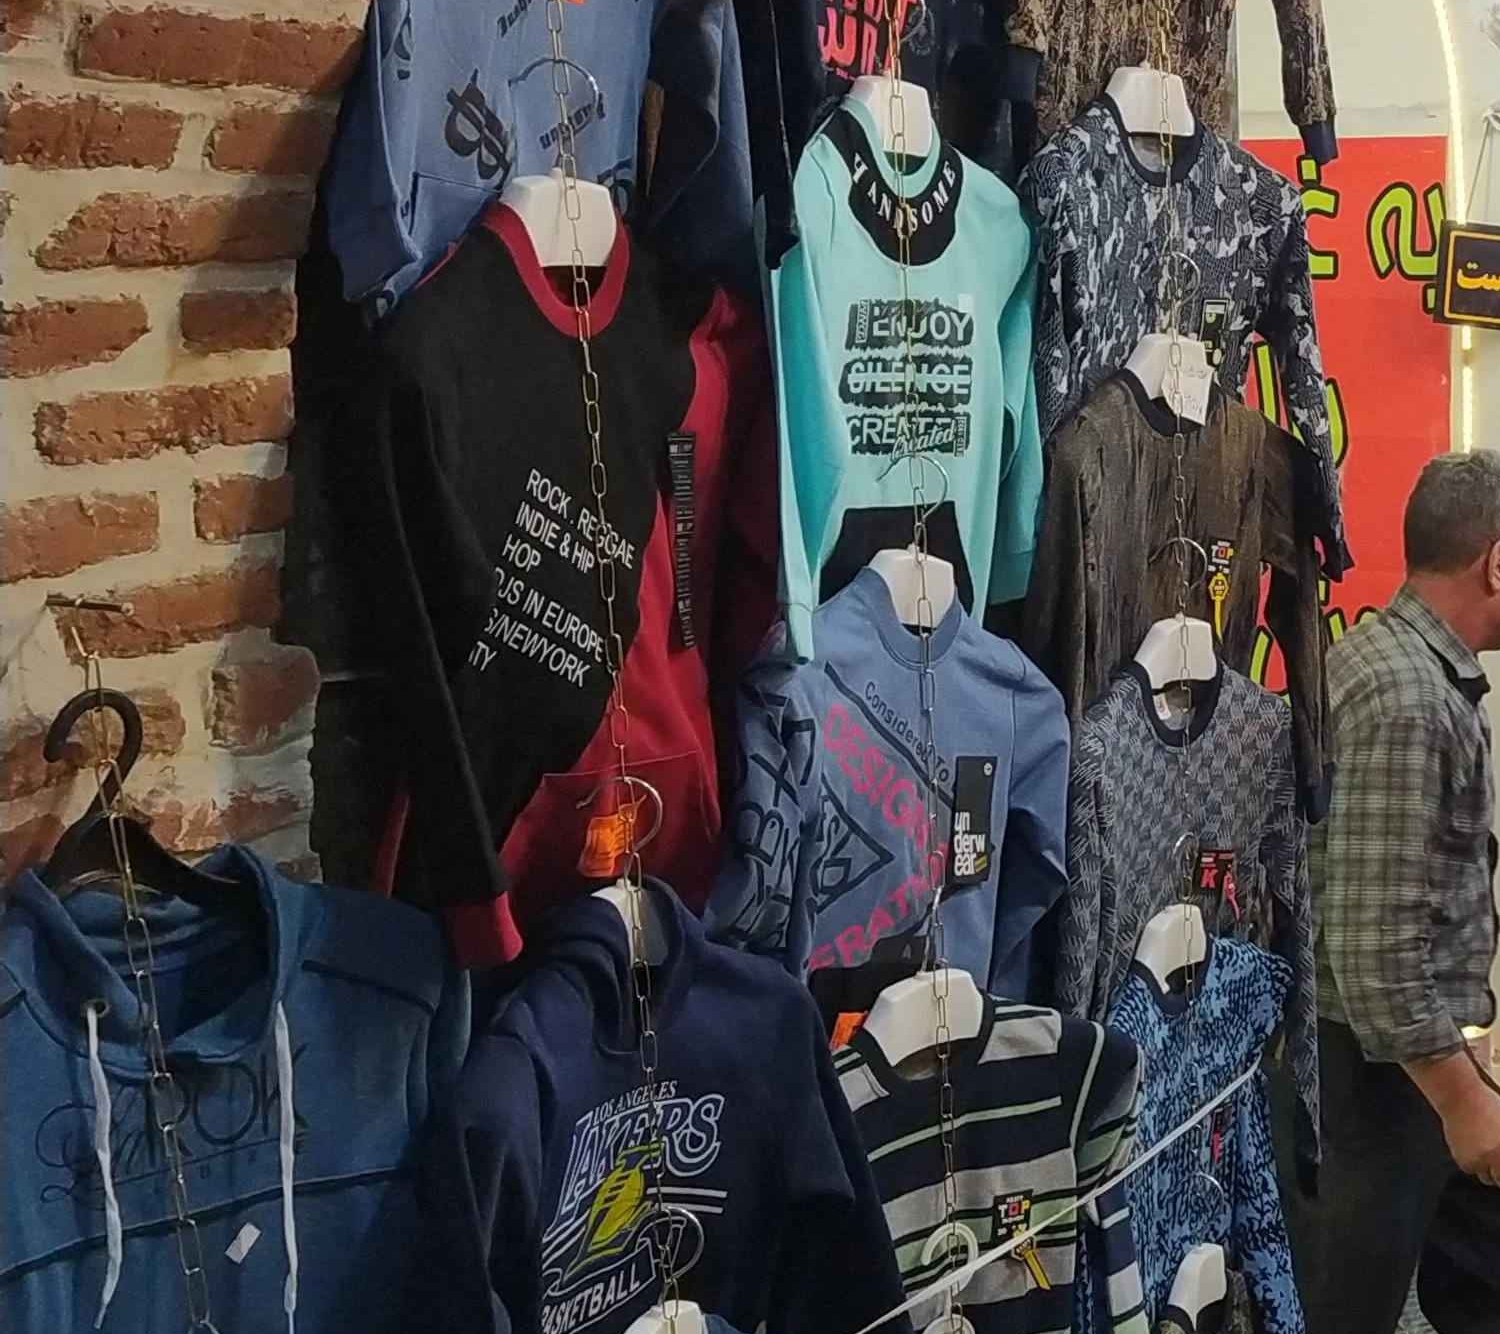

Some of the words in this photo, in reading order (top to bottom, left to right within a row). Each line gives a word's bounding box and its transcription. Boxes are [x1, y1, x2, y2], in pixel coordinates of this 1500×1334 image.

[853, 152, 956, 233] HANDSOME
[873, 307, 972, 342] ENJOY
[847, 361, 972, 395] SILENCE
[846, 417, 952, 446] CREAT
[515, 501, 561, 550] INDIE
[559, 532, 571, 558] &
[571, 541, 596, 574] HIP
[526, 468, 572, 519] ROCK
[577, 508, 636, 569] REGGAE
[501, 533, 542, 572] HOP
[522, 588, 545, 619] IN
[542, 600, 606, 663] EUROPE
[865, 681, 932, 764] Considered
[823, 701, 930, 854] DESIGN
[593, 1099, 615, 1126] LOS
[613, 1079, 678, 1115] ANGELES
[998, 1199, 1031, 1218] TOP
